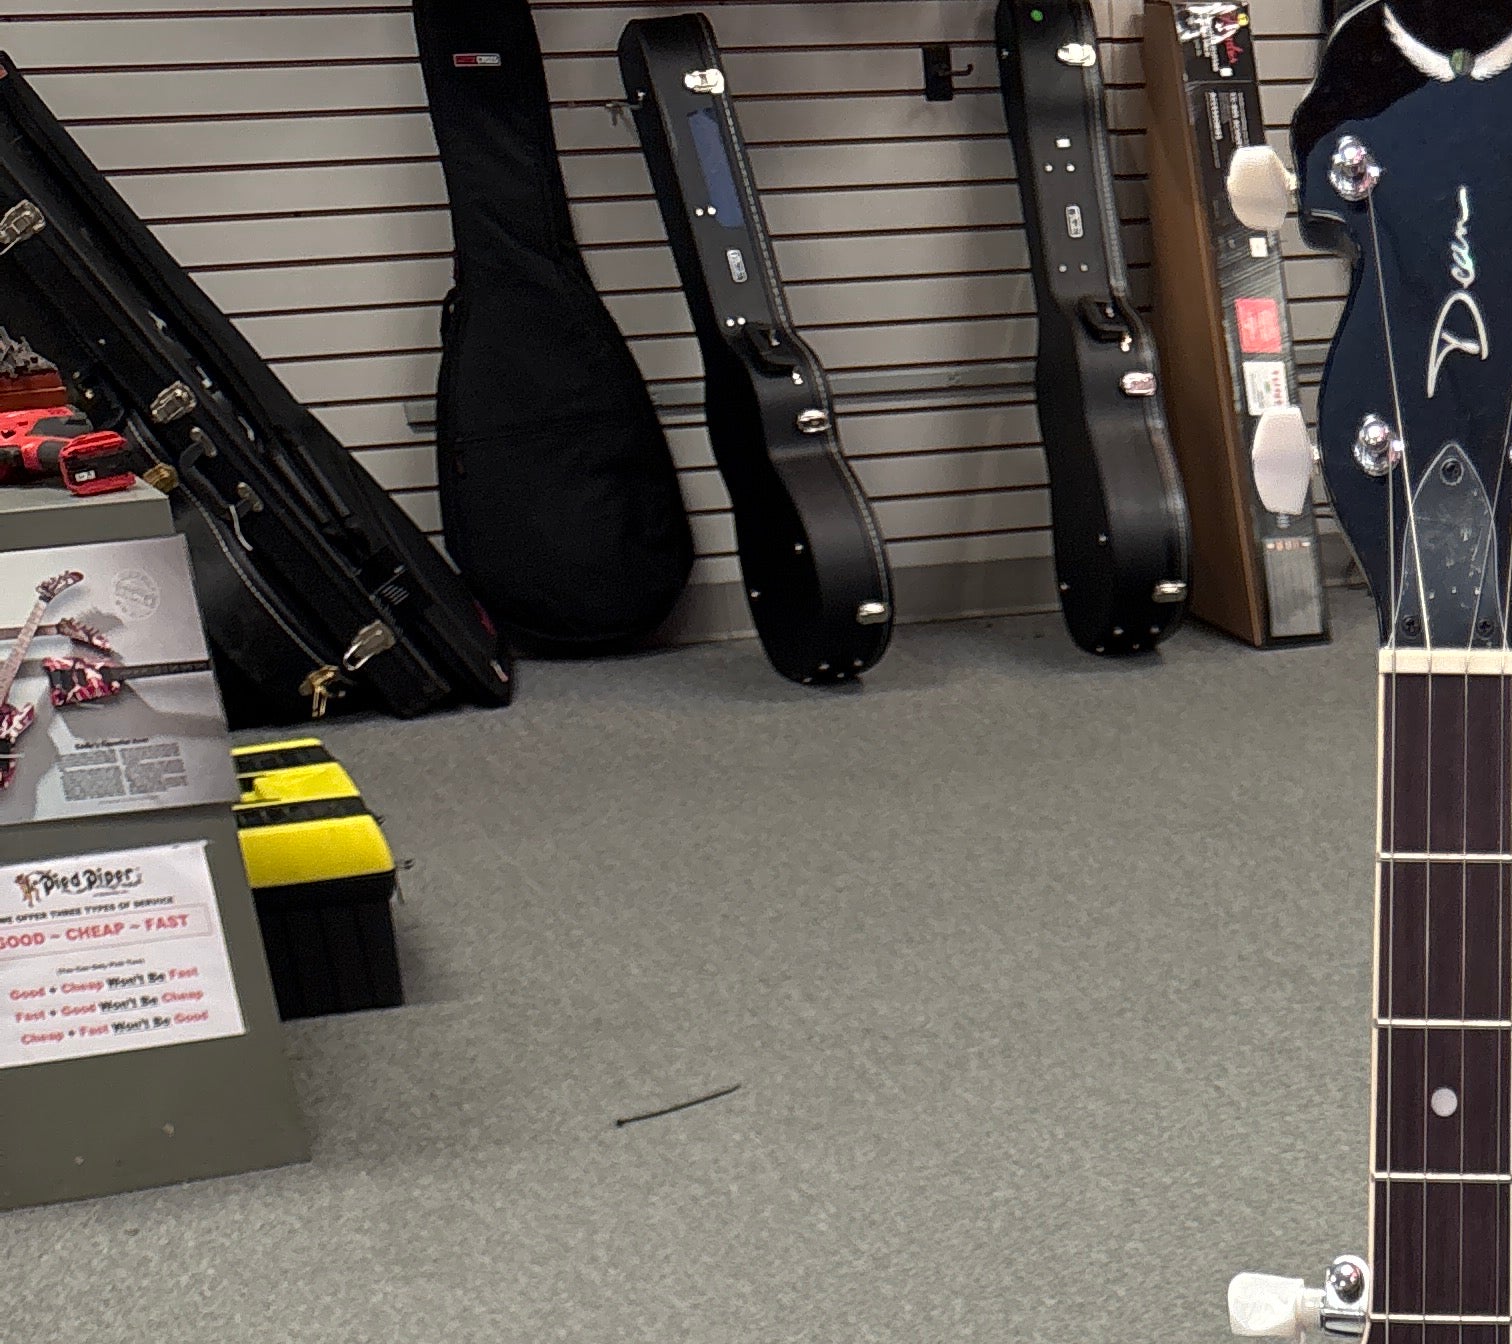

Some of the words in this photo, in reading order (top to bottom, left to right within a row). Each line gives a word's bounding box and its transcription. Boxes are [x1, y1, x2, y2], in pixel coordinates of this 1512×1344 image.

[1427, 184, 1489, 400] Dean
[66, 920, 124, 941] CHEAP
[144, 913, 189, 931] FAST
